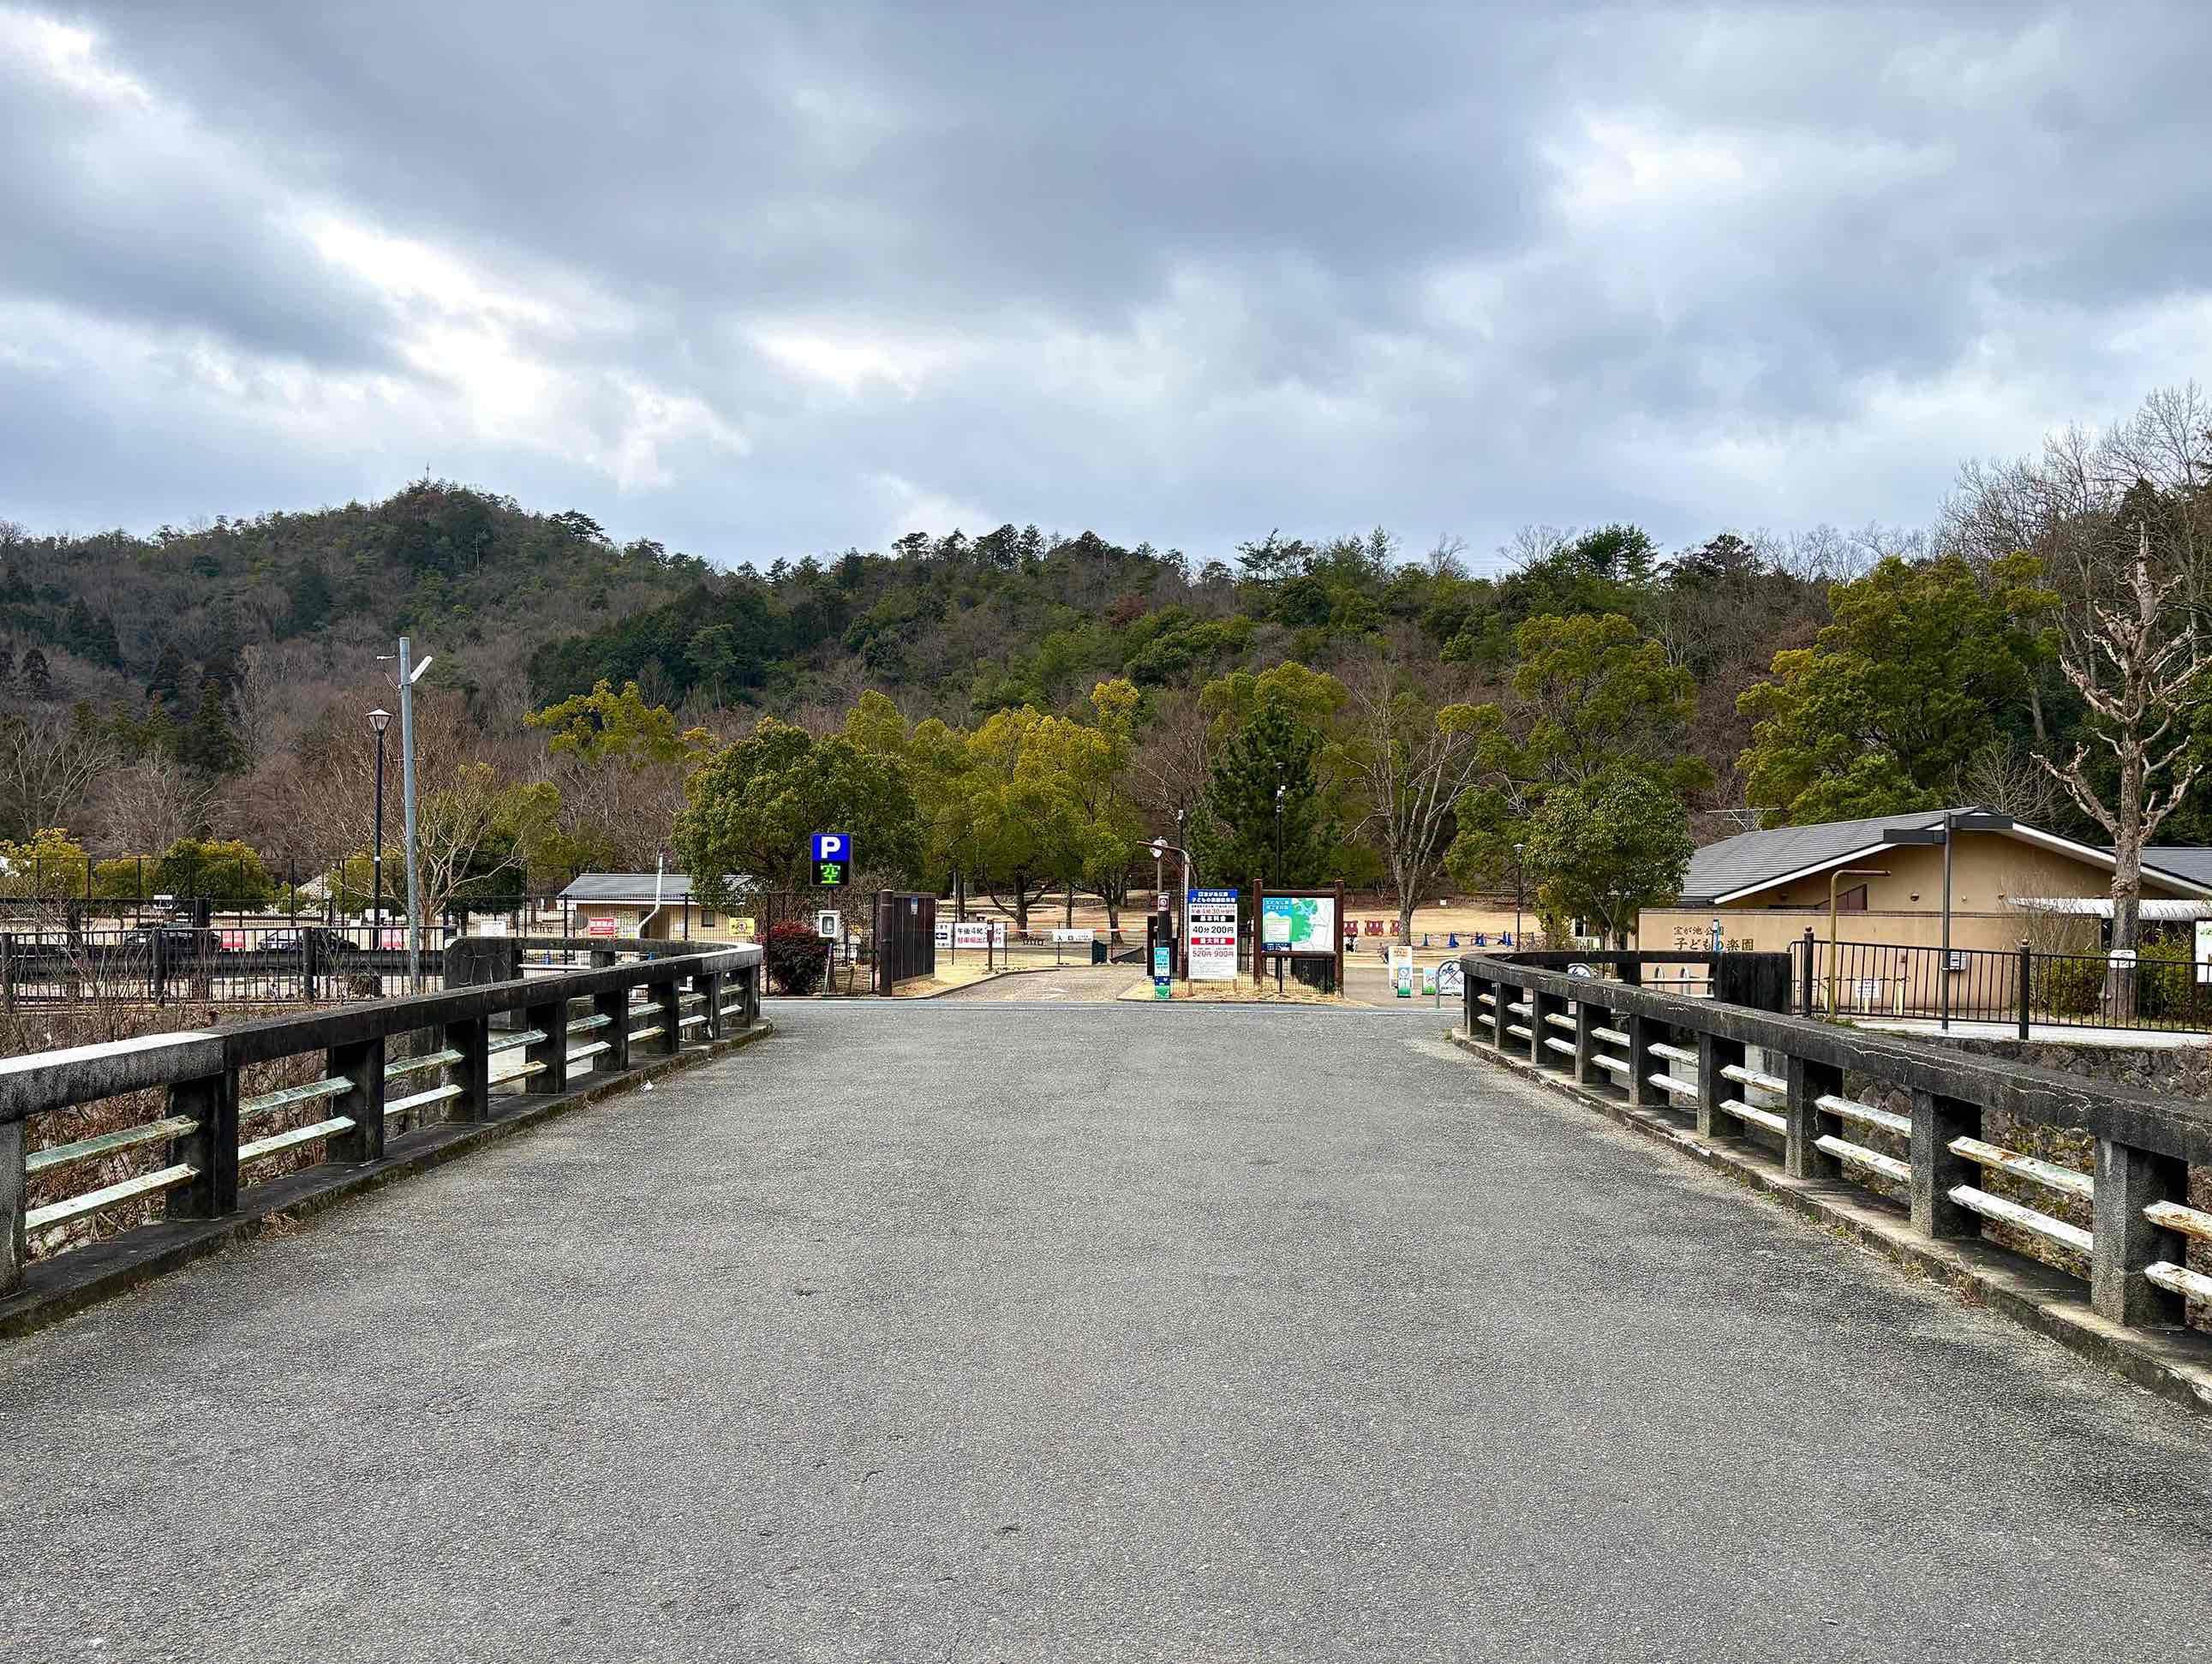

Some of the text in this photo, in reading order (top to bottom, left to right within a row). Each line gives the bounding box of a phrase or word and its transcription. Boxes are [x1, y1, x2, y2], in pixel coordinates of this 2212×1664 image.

[821, 836, 841, 859] P
[820, 863, 841, 883] 空
[1193, 925, 1235, 934] 40分 200円
